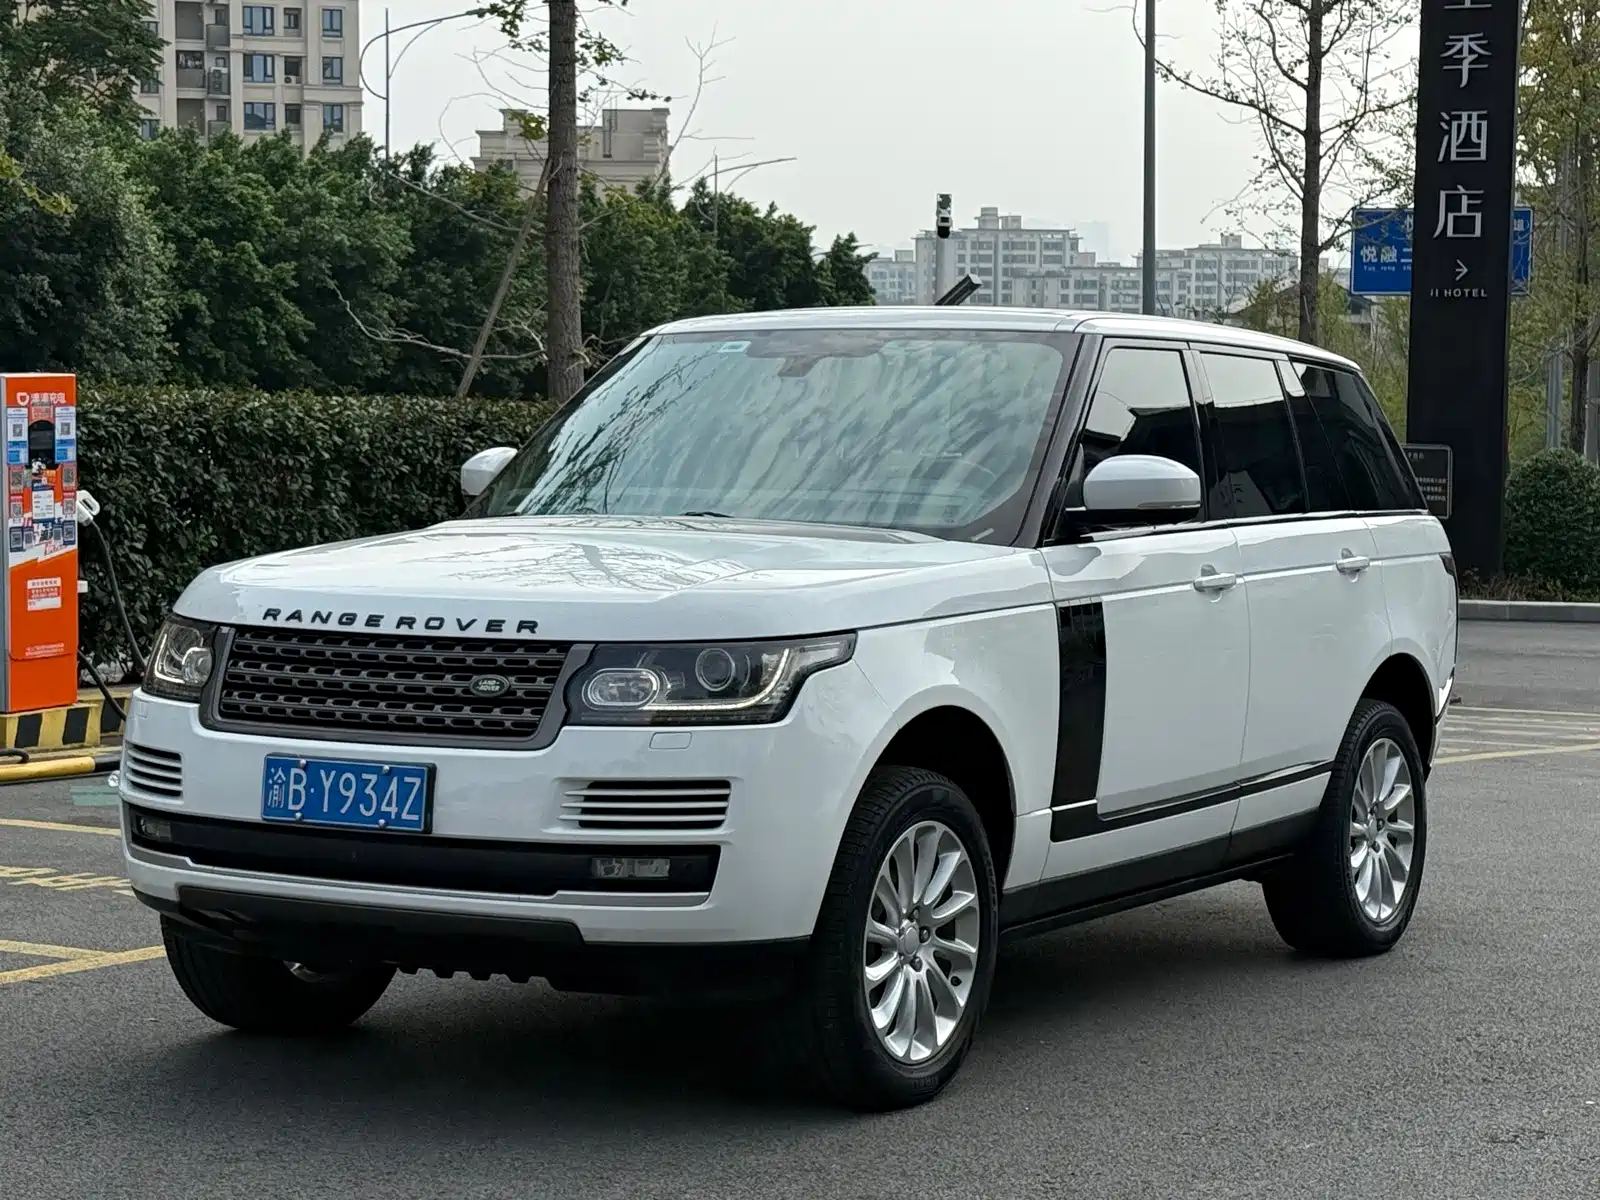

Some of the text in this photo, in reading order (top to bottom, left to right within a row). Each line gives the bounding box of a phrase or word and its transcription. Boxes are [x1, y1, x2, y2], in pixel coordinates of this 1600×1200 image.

[1433, 0, 1492, 238] 季酒店
[1444, 288, 1488, 298] HOTEL
[262, 607, 540, 635] RANGE ROVER
